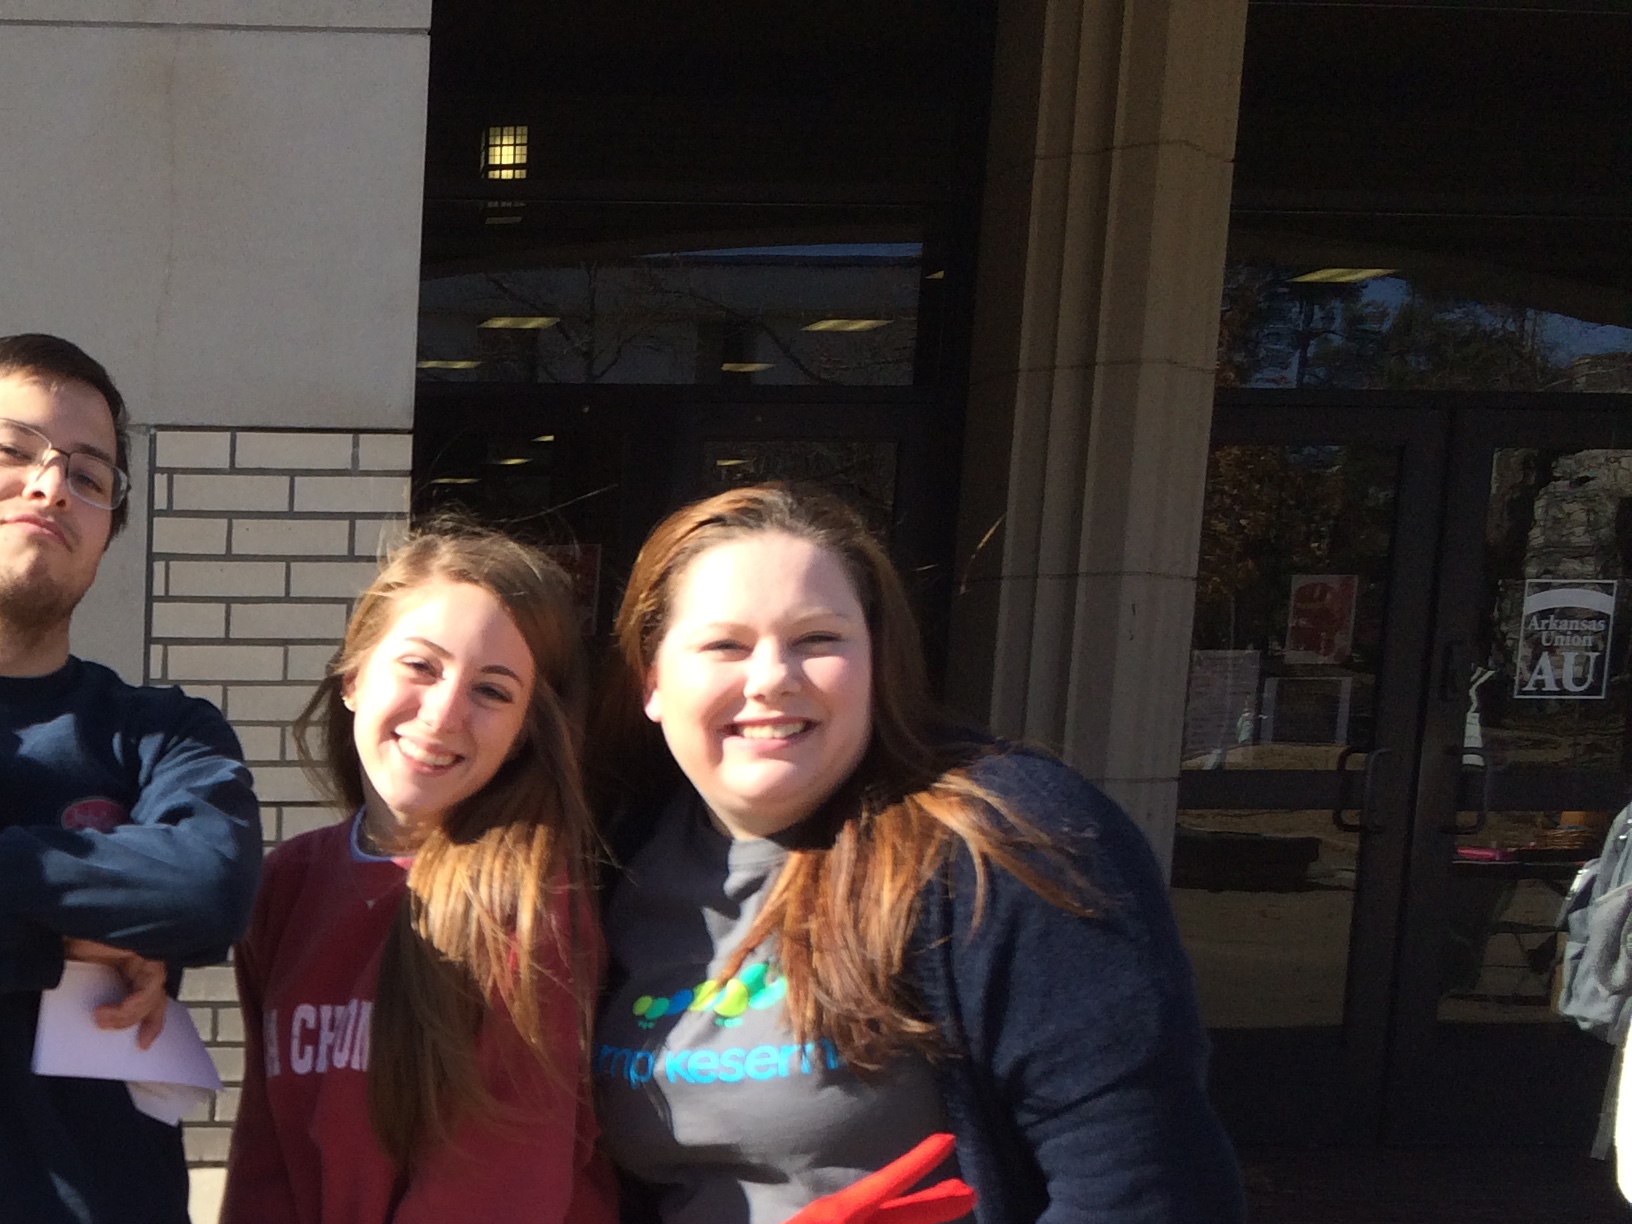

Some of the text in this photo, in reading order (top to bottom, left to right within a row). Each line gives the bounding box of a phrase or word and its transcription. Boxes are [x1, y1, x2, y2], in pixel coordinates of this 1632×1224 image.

[1527, 614, 1607, 632] Arkansas
[1540, 631, 1595, 647] Union
[1521, 650, 1602, 692] AU
